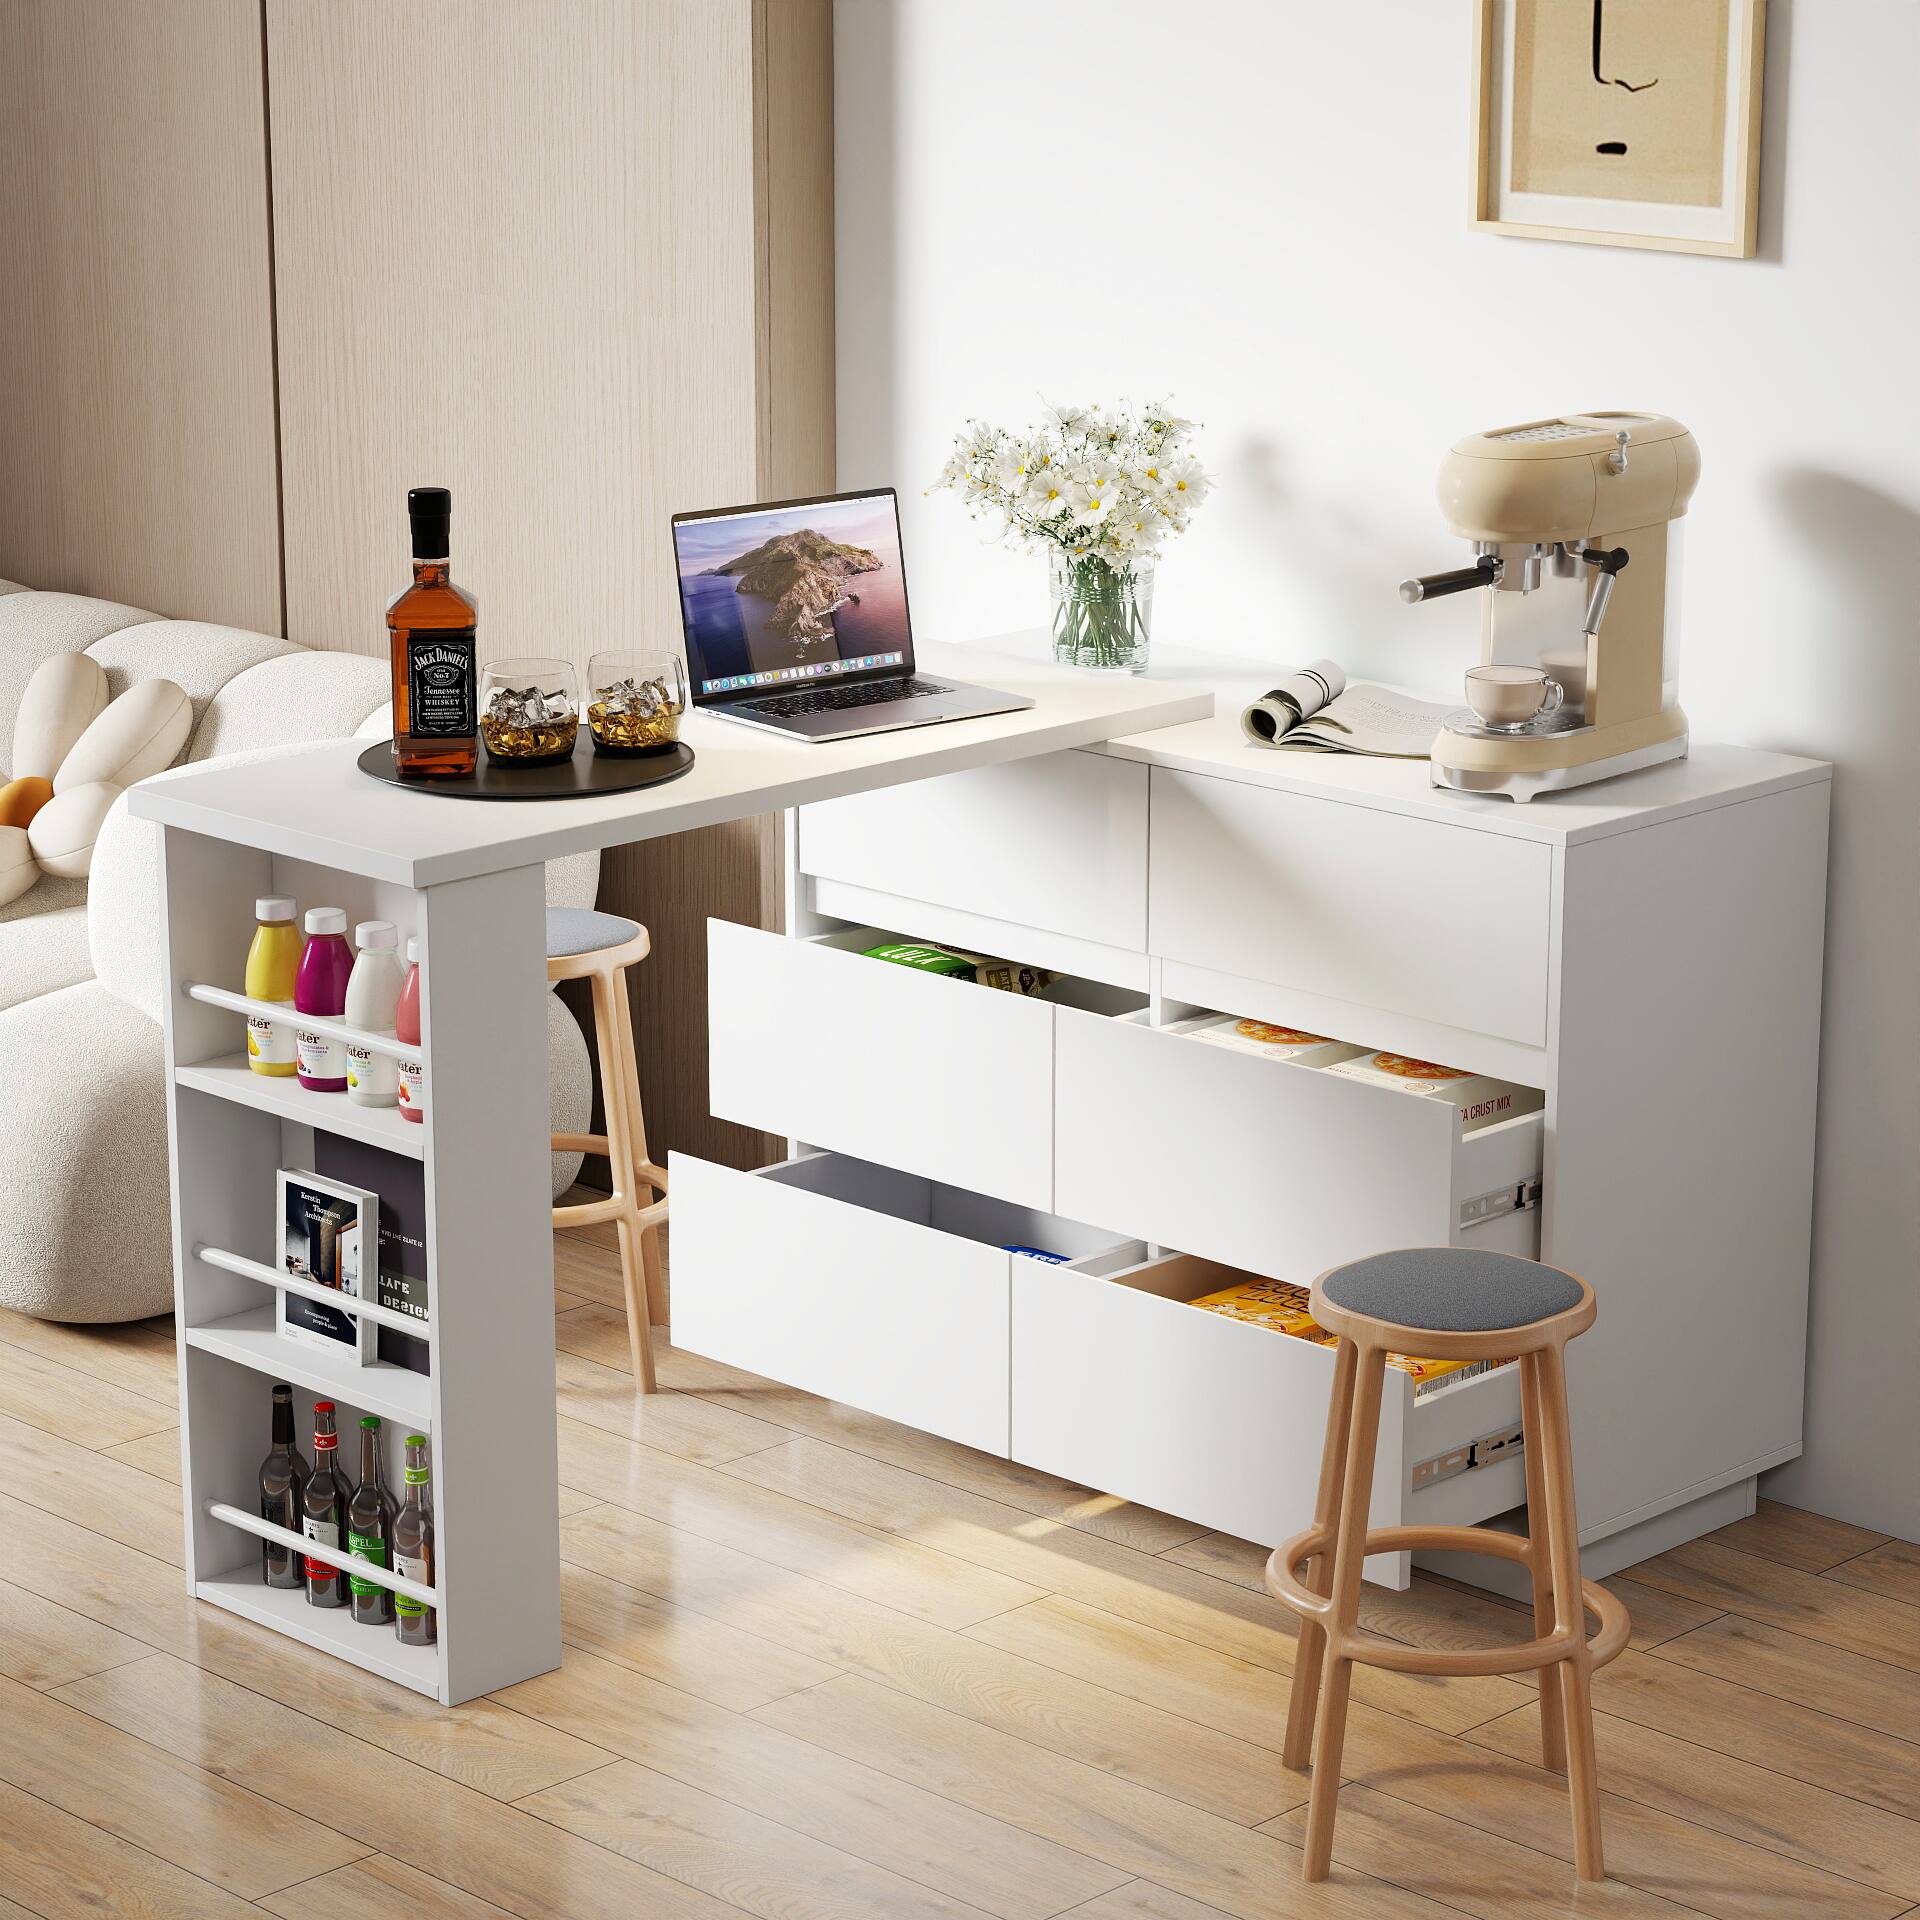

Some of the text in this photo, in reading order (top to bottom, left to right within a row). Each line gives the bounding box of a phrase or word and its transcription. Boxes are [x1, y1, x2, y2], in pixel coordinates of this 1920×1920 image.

[414, 652, 436, 670] JACK
[424, 686, 460, 694] Tennessee
[1470, 1099, 1496, 1120] CRUST
[1496, 1094, 1511, 1111] MIX
[313, 1204, 340, 1219] Thompson
